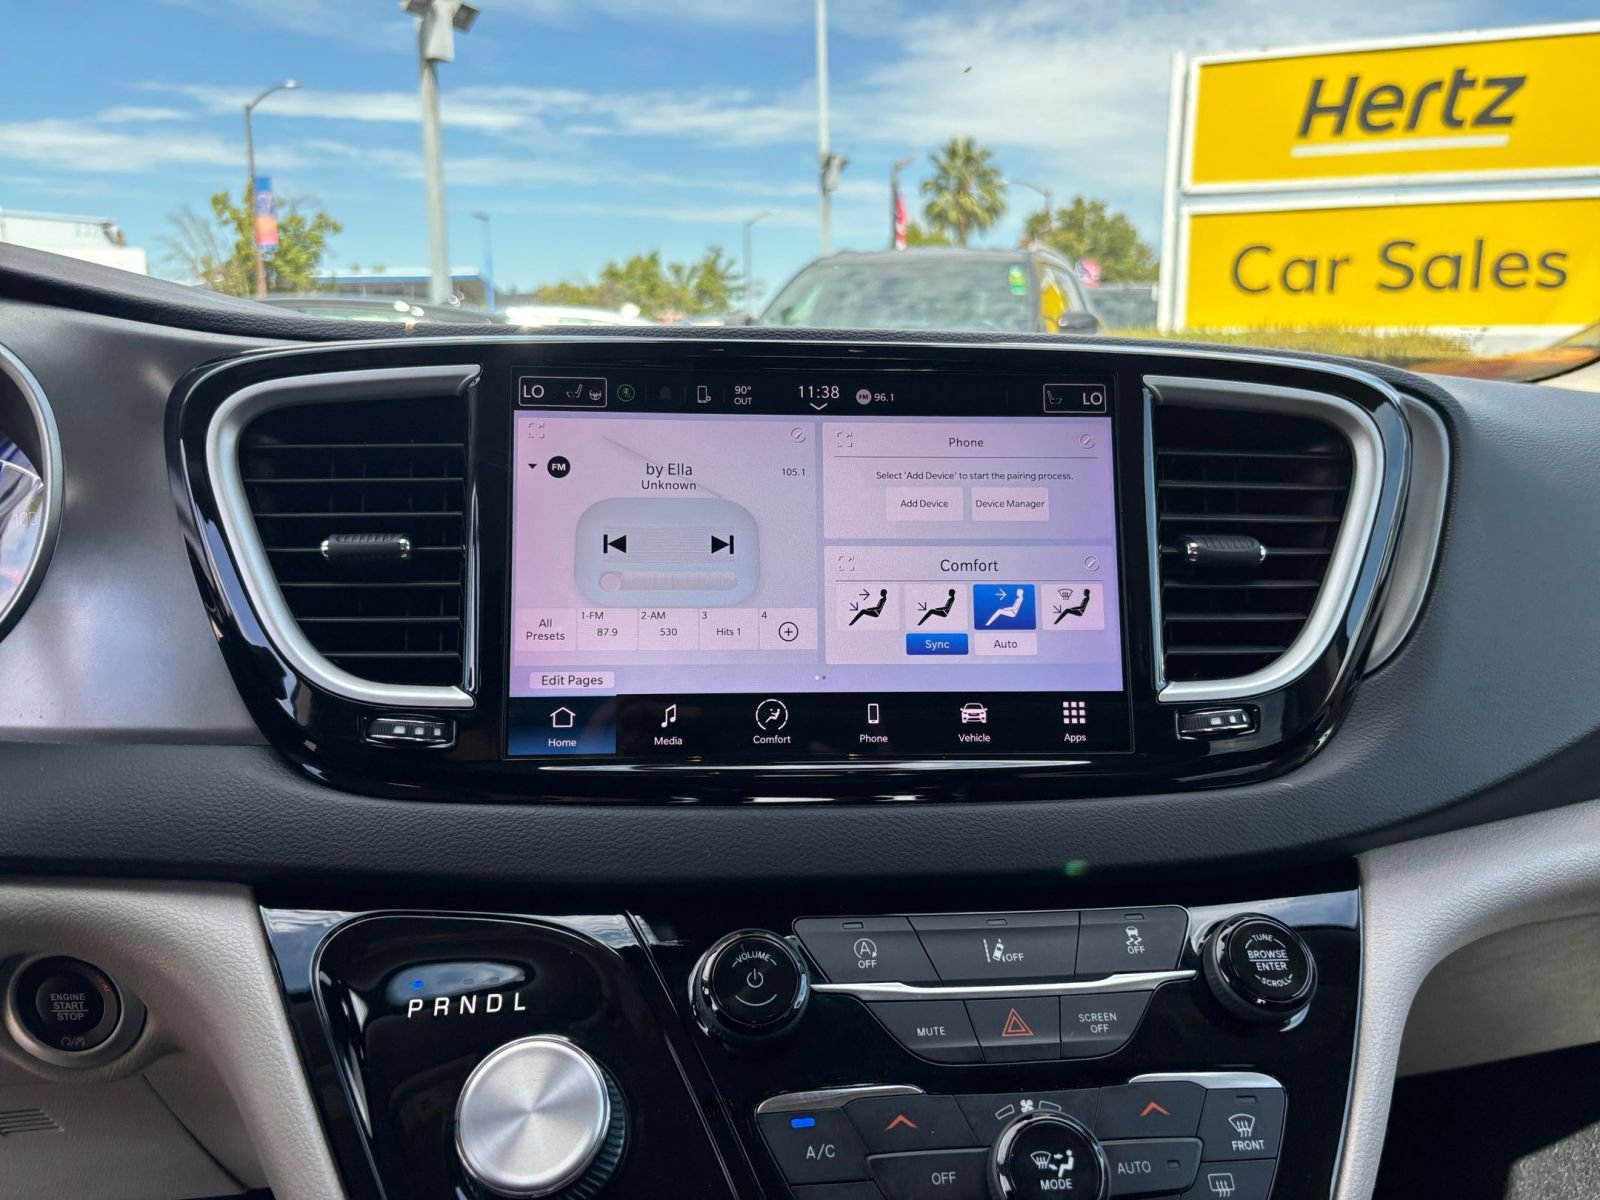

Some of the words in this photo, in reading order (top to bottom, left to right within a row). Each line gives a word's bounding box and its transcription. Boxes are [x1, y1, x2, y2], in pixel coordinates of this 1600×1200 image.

[1297, 66, 1528, 139] Hertz
[1232, 243, 1351, 294] Car
[1376, 237, 1569, 292] Sales
[523, 384, 545, 398] LO
[798, 385, 840, 399] 11:38
[734, 397, 752, 405] OUT
[874, 393, 894, 402] 96.1
[1082, 392, 1103, 405] LO
[948, 437, 984, 448] Phone
[551, 463, 567, 472] FM
[646, 463, 664, 477] by
[668, 463, 693, 475] Ella
[781, 468, 806, 477] 105.1
[876, 471, 903, 480] Select
[904, 471, 924, 480] 'Add
[925, 471, 957, 480] Device'
[958, 472, 968, 480] to
[969, 472, 990, 480] start
[990, 472, 1006, 480] the
[1007, 472, 1036, 482] pairing
[1037, 473, 1074, 482] process.
[641, 480, 697, 491] Unknown
[900, 499, 918, 508] Add
[919, 499, 949, 508] Device
[975, 499, 1005, 508] Device
[1006, 499, 1045, 510] Manager
[940, 559, 999, 572] Comfort
[581, 611, 604, 620] 1-FM
[641, 611, 666, 620] 2-AM
[701, 611, 708, 620] 3
[761, 611, 767, 620] 4
[538, 618, 552, 628] All
[526, 631, 565, 641] Presets
[596, 627, 618, 637] 87.9
[659, 627, 678, 637] 530
[716, 627, 734, 637] Hits
[924, 638, 950, 650] Sync
[993, 639, 1018, 649] Auto
[541, 674, 565, 686] Edit
[569, 675, 604, 688] Pages
[654, 736, 683, 746] Media
[753, 734, 791, 744] Comfort
[859, 733, 888, 743] Phone
[958, 733, 991, 742] Vehicle
[1064, 733, 1087, 744] Apps
[548, 738, 577, 748] Home
[1251, 933, 1274, 942] TUNE
[1127, 945, 1145, 955] OFF
[1247, 949, 1288, 959] BROWSE
[735, 951, 771, 964] VOLUME
[1005, 953, 1025, 962] OFF
[858, 960, 877, 969] OFF
[1255, 961, 1288, 971] ENTER
[1260, 977, 1291, 987] SCROLL
[50, 993, 86, 1001] ENGINE
[53, 1001, 85, 1010] START
[56, 1012, 85, 1021] STOP
[1078, 1012, 1117, 1023] SCREEN
[916, 1026, 946, 1037] MUTE
[1090, 1023, 1109, 1034] OFF
[1231, 1140, 1265, 1151] FRONT
[805, 1144, 836, 1160] A/C
[1117, 1161, 1151, 1174] AUTO
[931, 1171, 957, 1186] OFF
[1040, 1178, 1073, 1190] MODE
